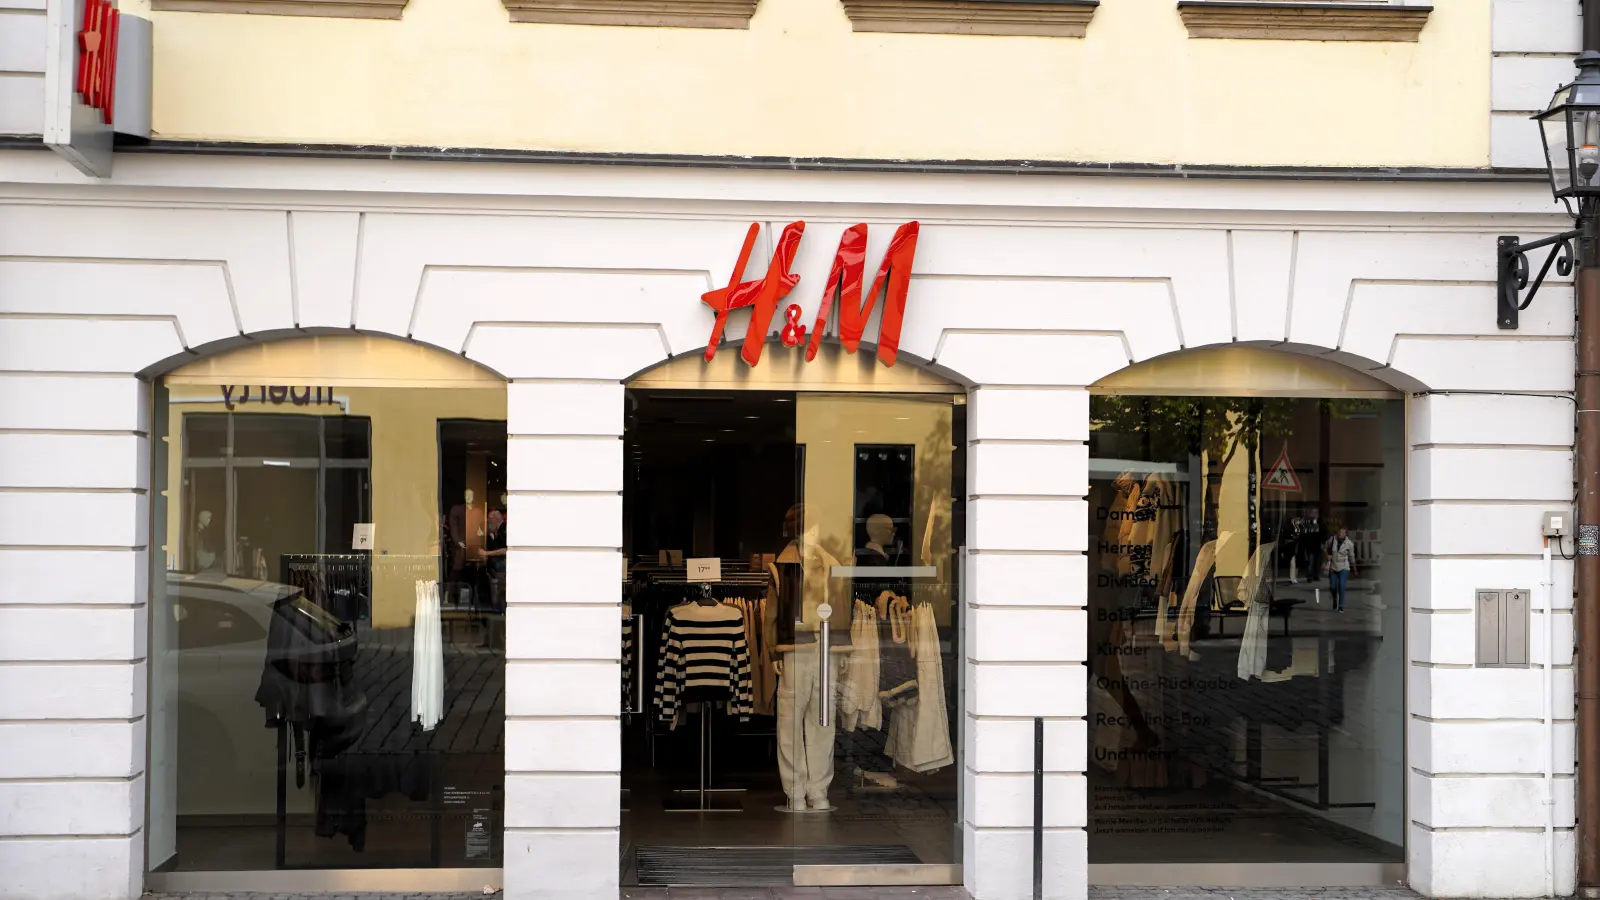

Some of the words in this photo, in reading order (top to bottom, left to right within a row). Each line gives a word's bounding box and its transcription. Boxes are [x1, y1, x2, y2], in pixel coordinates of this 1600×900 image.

[700, 220, 920, 368] H&M
[1097, 540, 1153, 554] Herren
[1097, 573, 1158, 588] Divided
[1097, 642, 1150, 656] Kinder
[1097, 676, 1237, 694] Online-Rückgabe
[1096, 712, 1212, 730] Recyling-Box
[1095, 747, 1127, 761] Und
